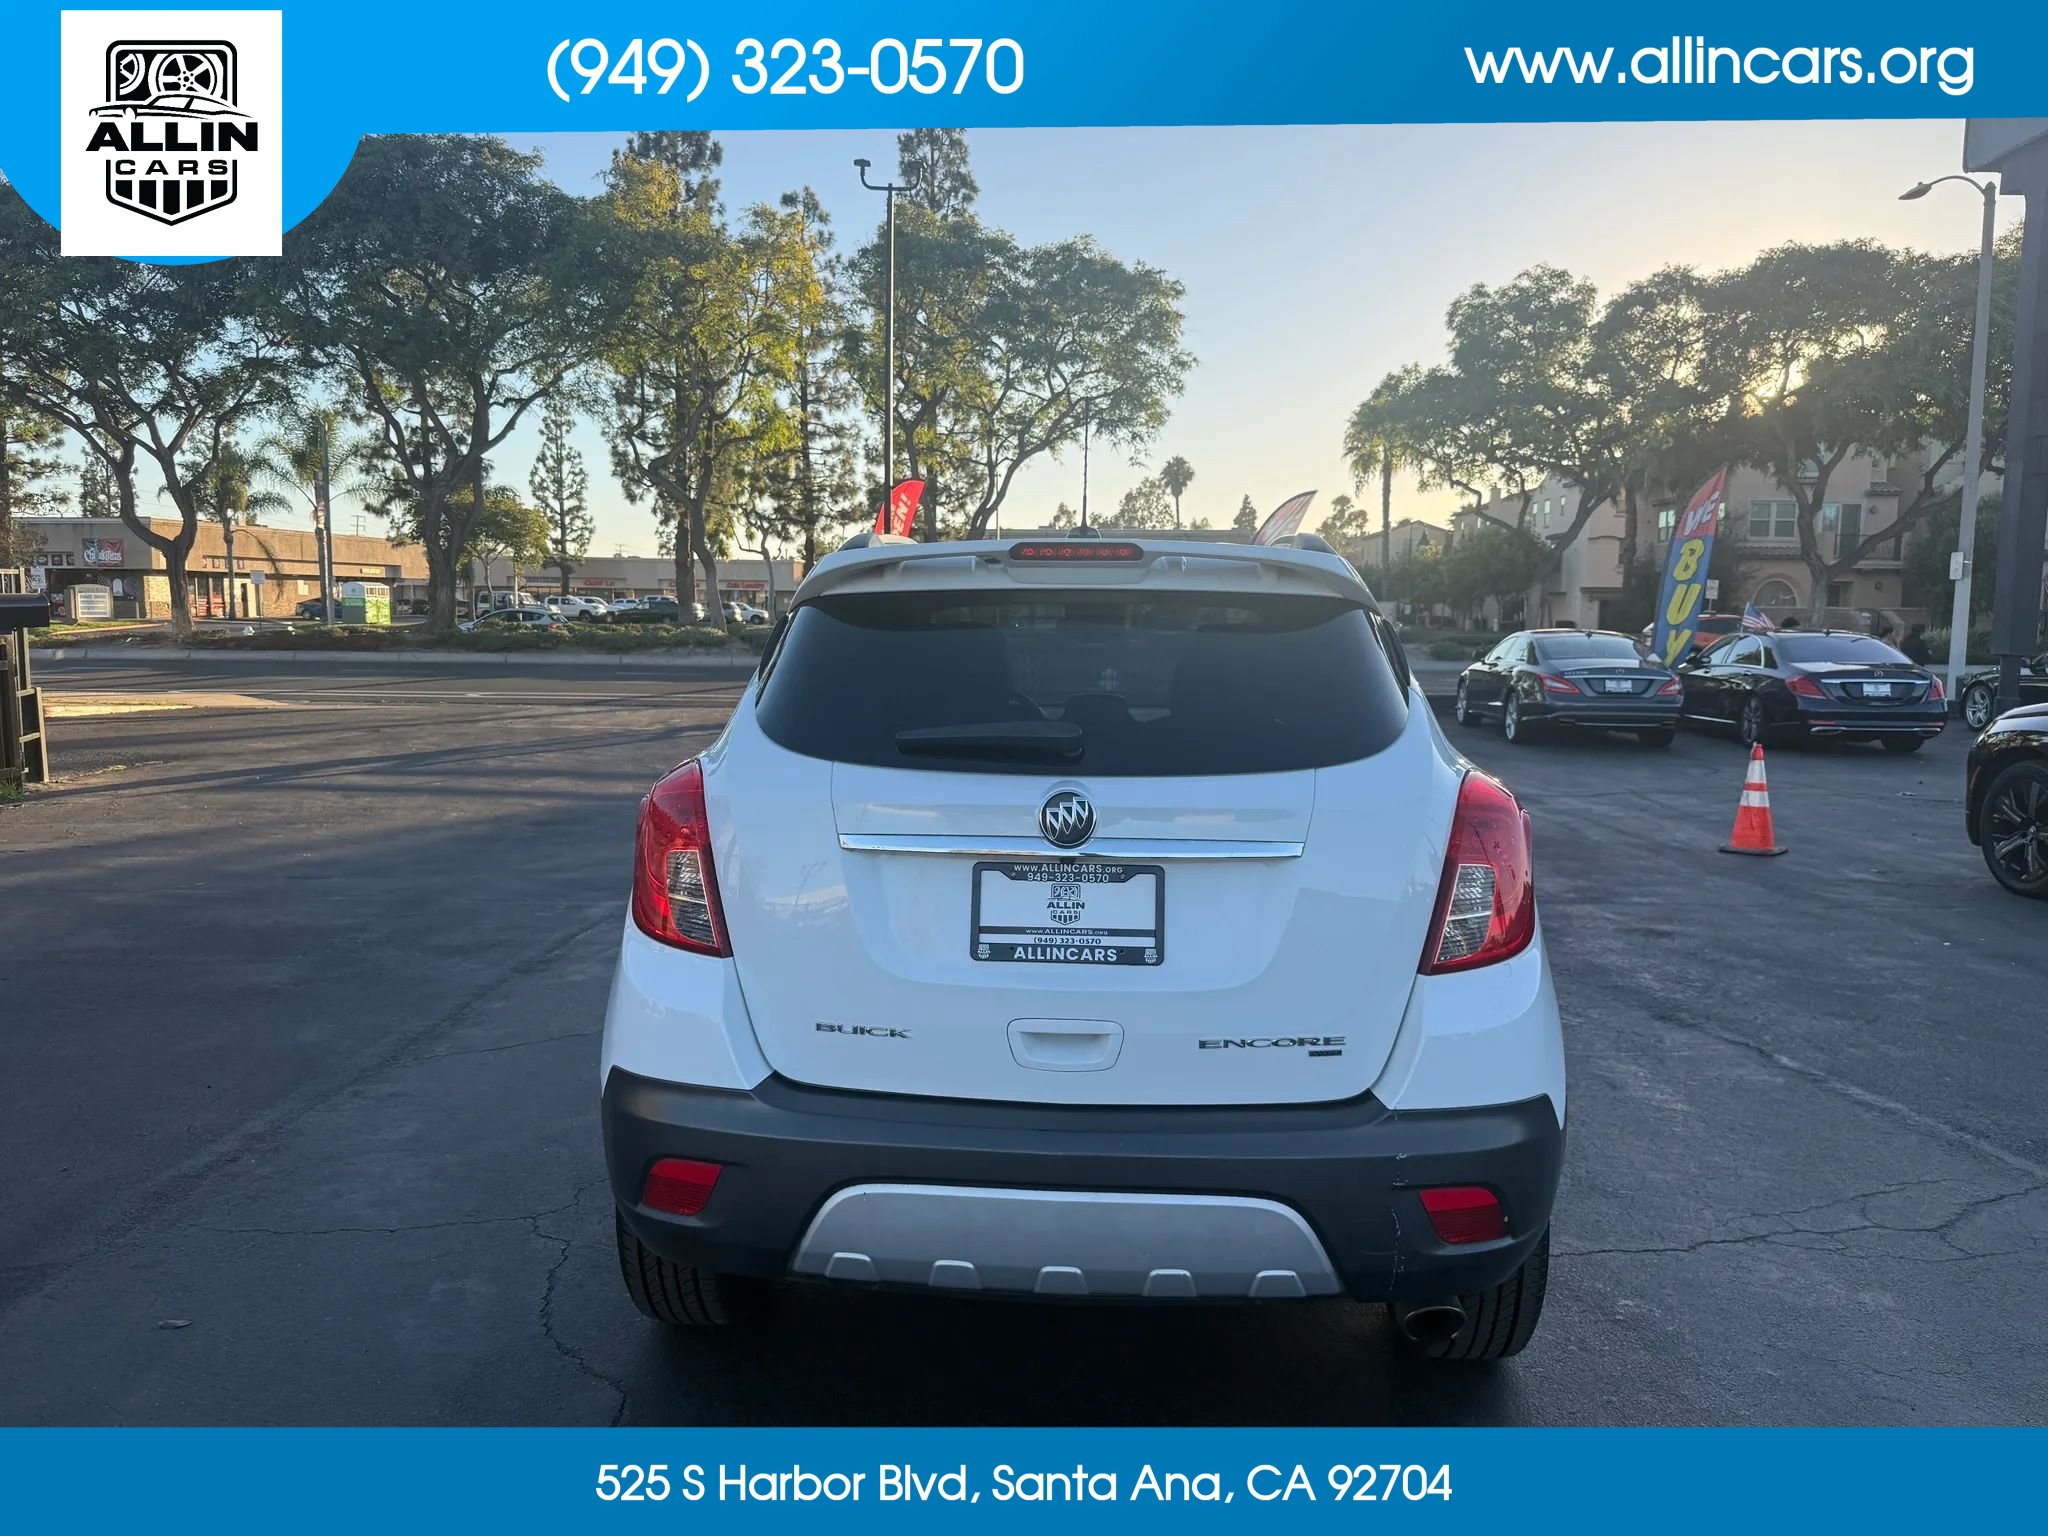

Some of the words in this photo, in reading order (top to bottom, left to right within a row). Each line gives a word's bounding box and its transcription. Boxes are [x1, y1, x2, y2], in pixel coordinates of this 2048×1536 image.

[1683, 490, 1720, 536] WE
[1664, 538, 1705, 666] BUY
[1027, 872, 1109, 883] 949-323-0570
[1046, 901, 1085, 910] ALLIN
[1033, 936, 1058, 945] (949)
[1013, 946, 1118, 962] ALLINCARS
[816, 1022, 912, 1039] BUICK
[1198, 1034, 1346, 1050] ENCORE
